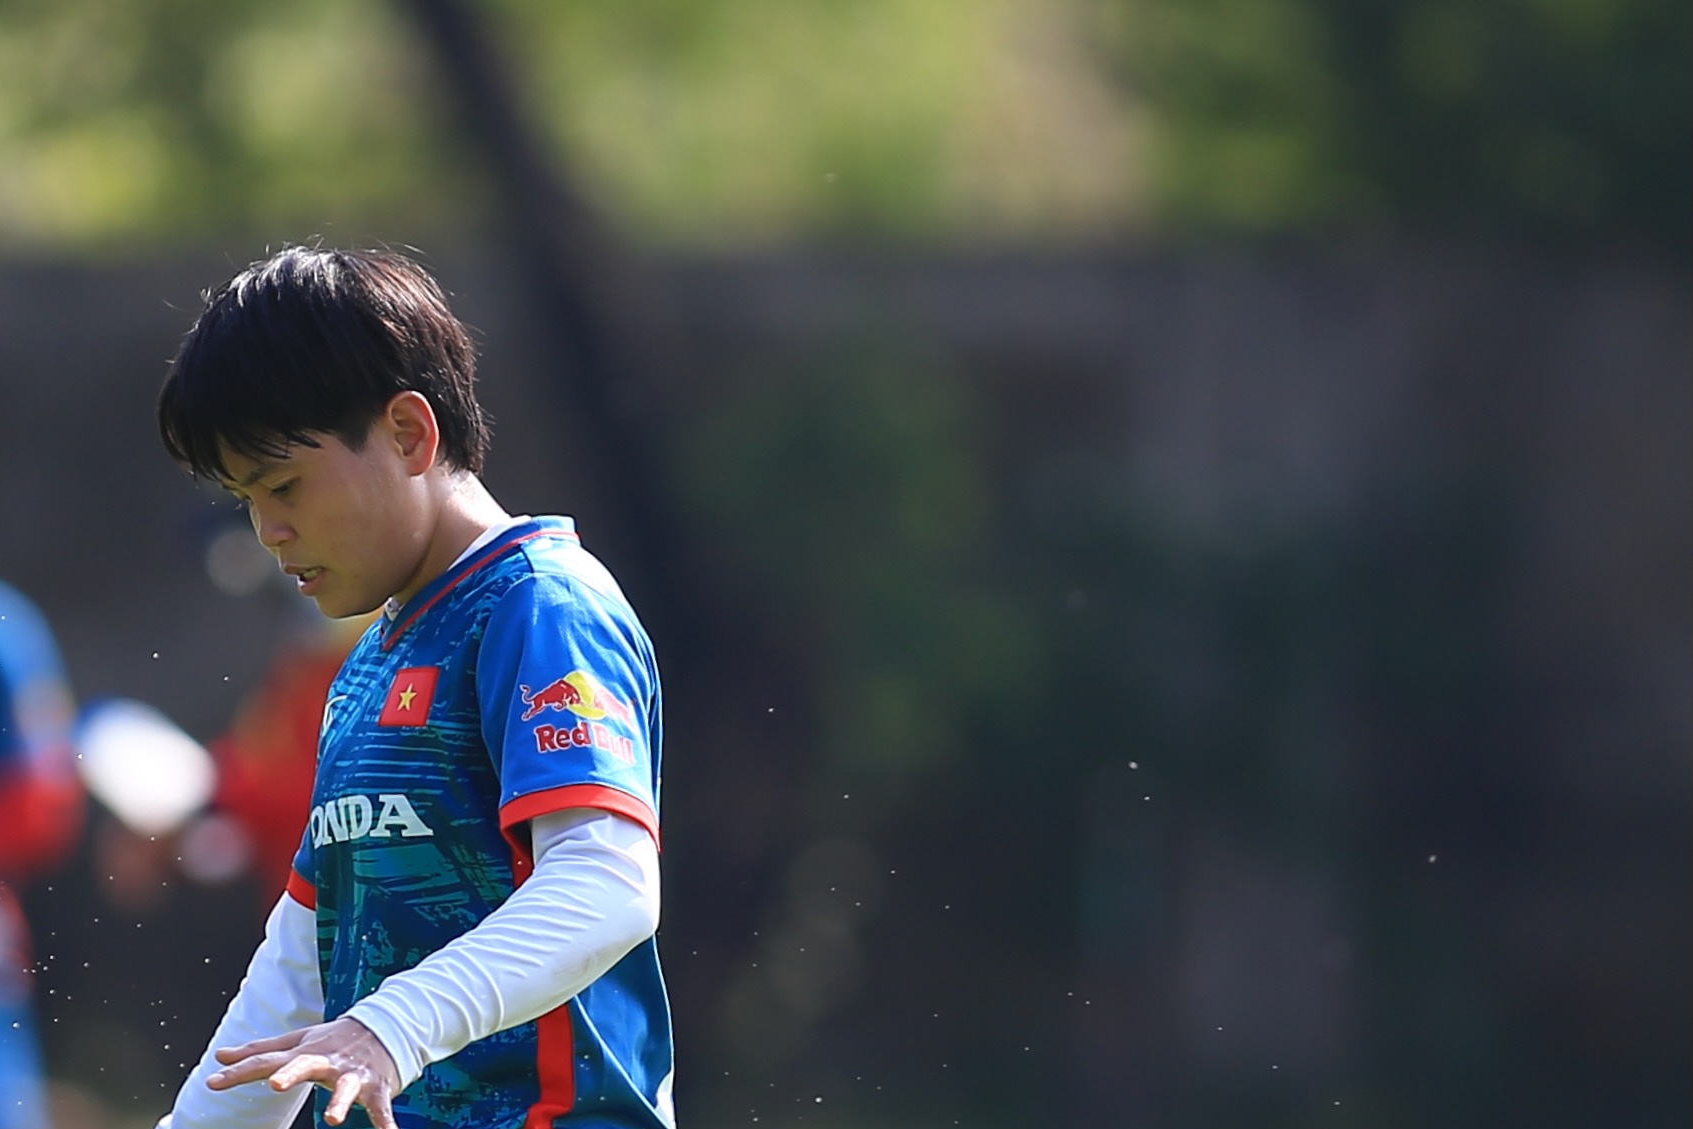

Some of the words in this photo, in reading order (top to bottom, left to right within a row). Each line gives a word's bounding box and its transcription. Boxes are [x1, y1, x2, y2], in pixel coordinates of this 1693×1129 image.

[534, 720, 592, 753] Red
[592, 722, 637, 765] Bull
[310, 794, 434, 849] ONDA
